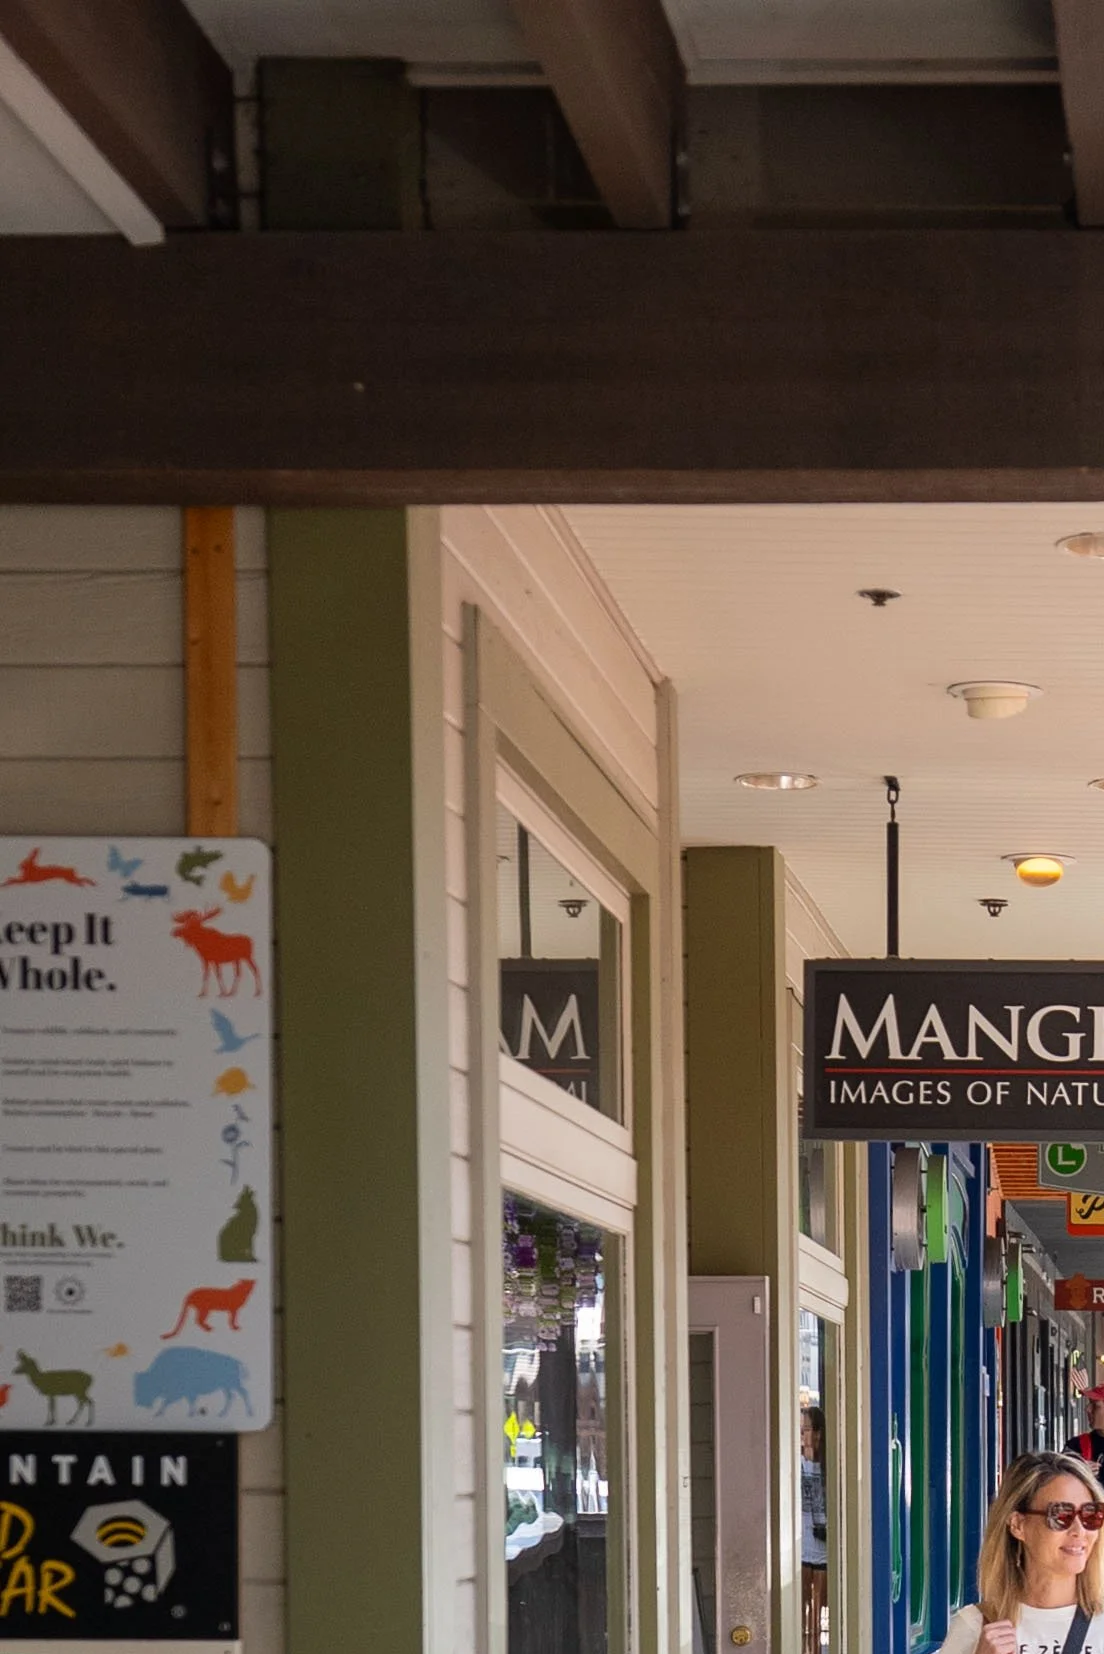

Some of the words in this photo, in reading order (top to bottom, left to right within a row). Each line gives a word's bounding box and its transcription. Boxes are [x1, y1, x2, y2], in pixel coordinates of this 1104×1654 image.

[0, 921, 75, 955] eep
[84, 912, 116, 945] It
[829, 1080, 951, 1105] IMAGES
[966, 1081, 1011, 1105] OF
[72, 1223, 125, 1249] We.
[9, 1453, 188, 1486] NTAIN
[0, 1555, 76, 1618] AR
